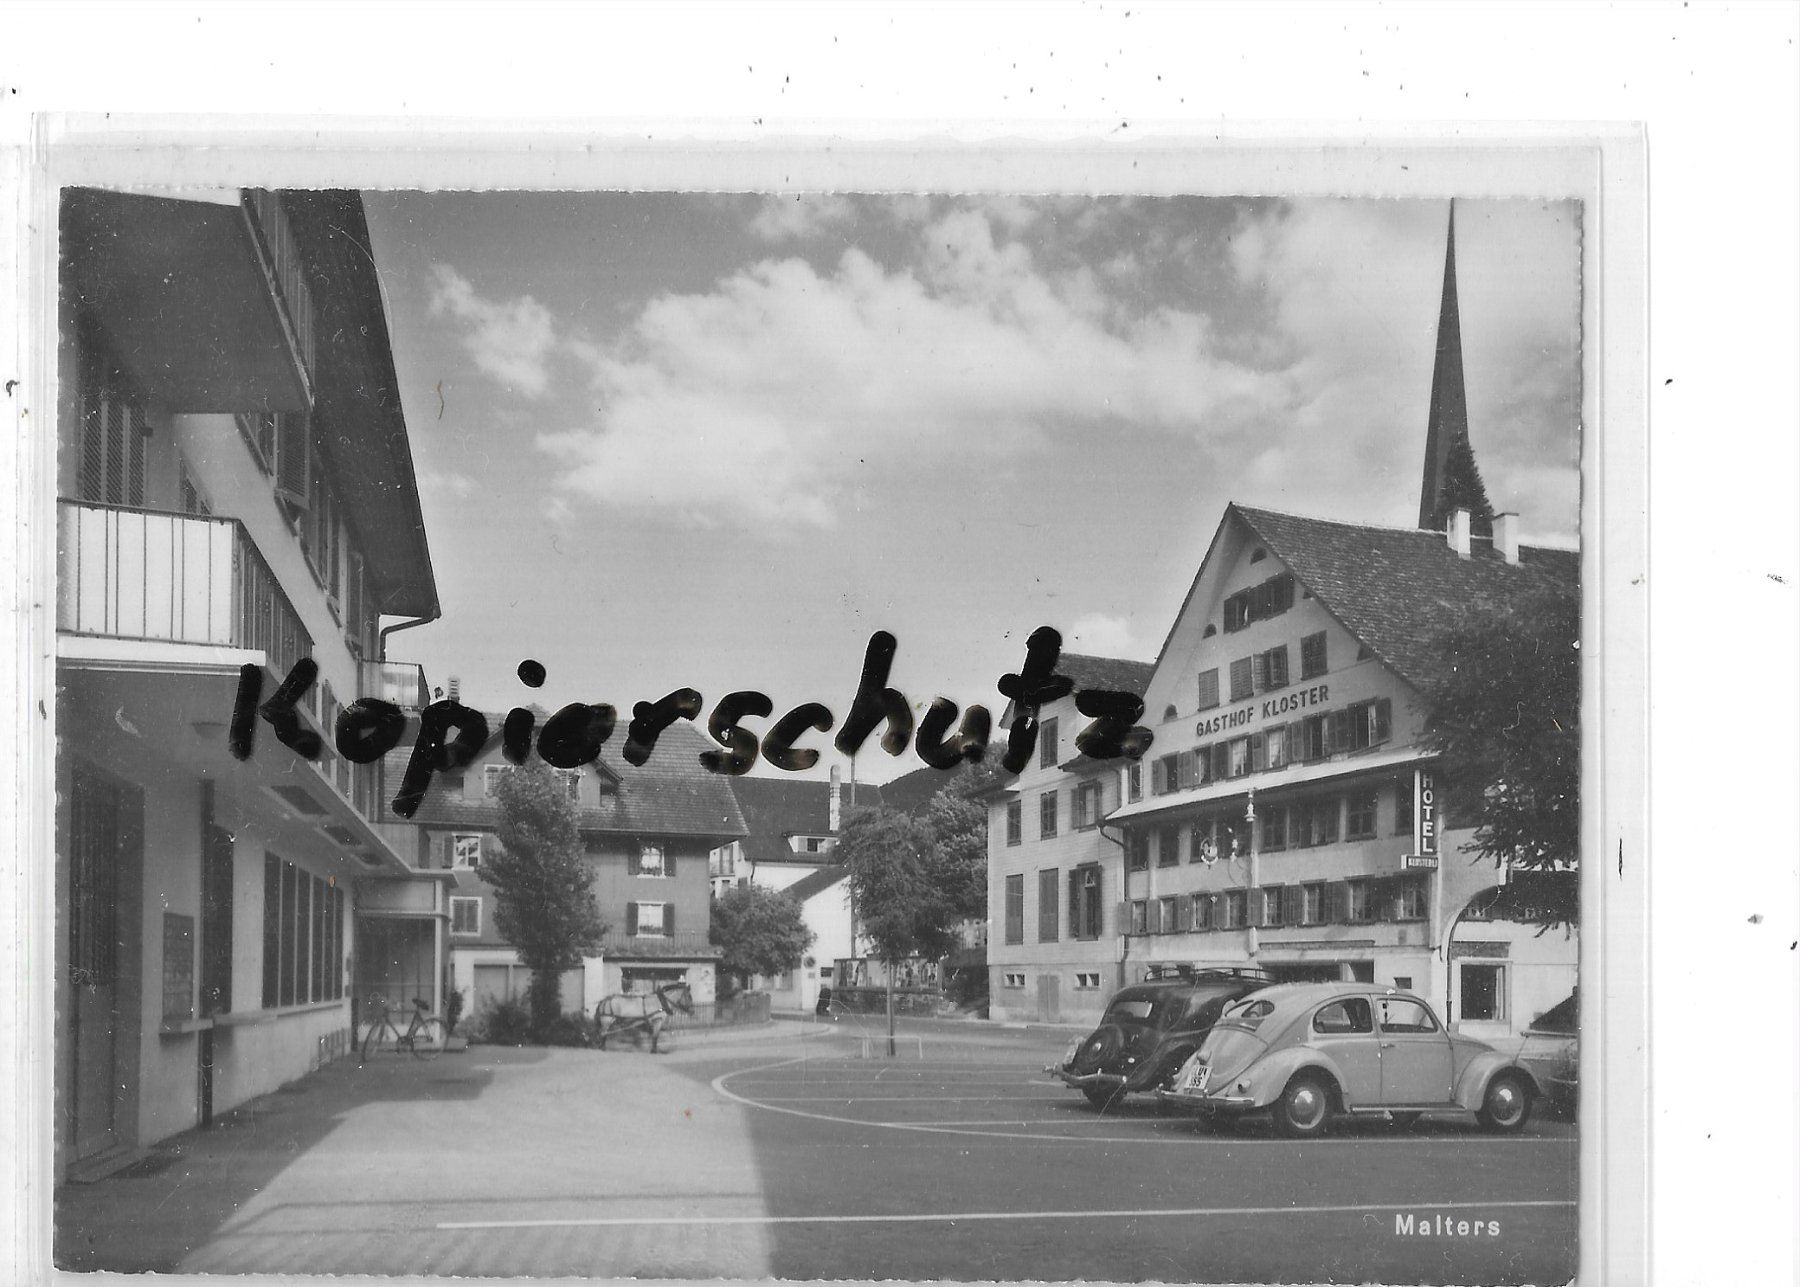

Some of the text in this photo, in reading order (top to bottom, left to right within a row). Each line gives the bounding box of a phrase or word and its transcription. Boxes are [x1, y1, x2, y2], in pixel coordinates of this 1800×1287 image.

[1196, 685, 1329, 737] GASTHOF KLOSTER
[1422, 774, 1434, 853] HOTEL
